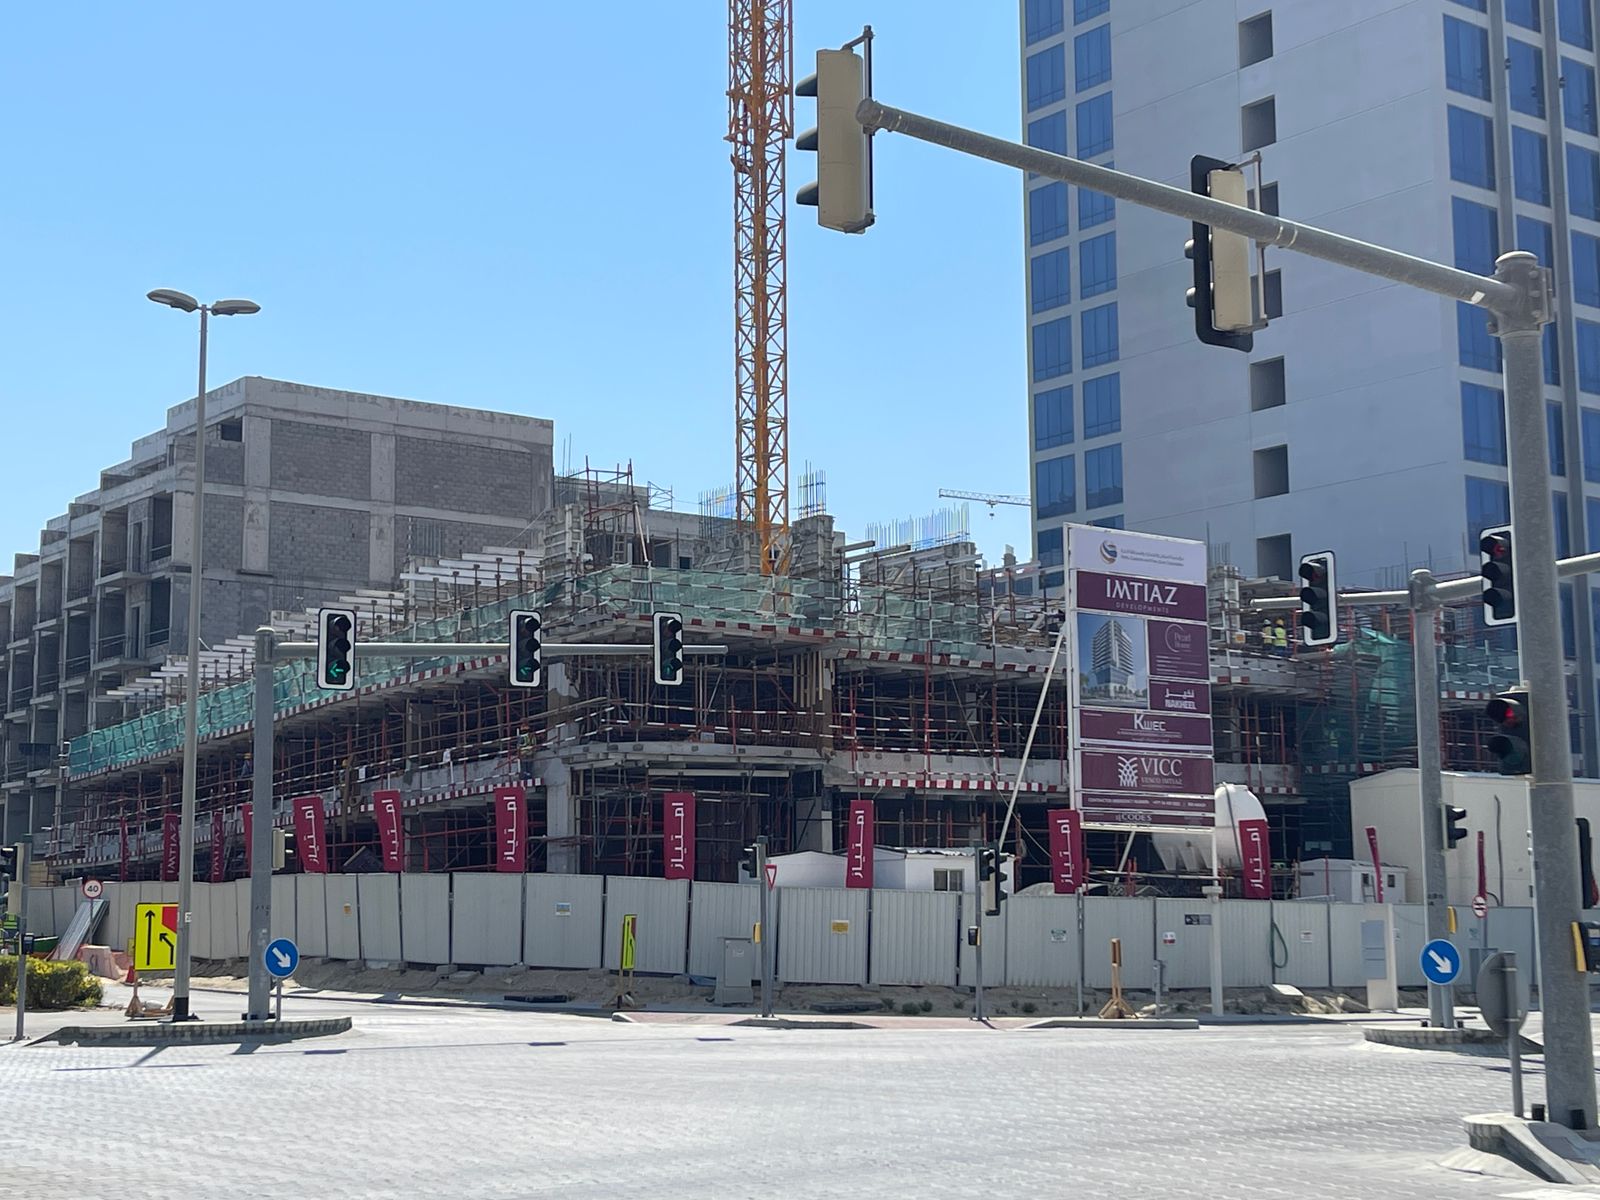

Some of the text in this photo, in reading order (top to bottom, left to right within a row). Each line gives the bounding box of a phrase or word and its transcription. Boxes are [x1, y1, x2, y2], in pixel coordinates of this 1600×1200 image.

[1106, 578, 1178, 605] IMTIAZ
[1141, 757, 1182, 776] VICC
[87, 884, 99, 893] 40
